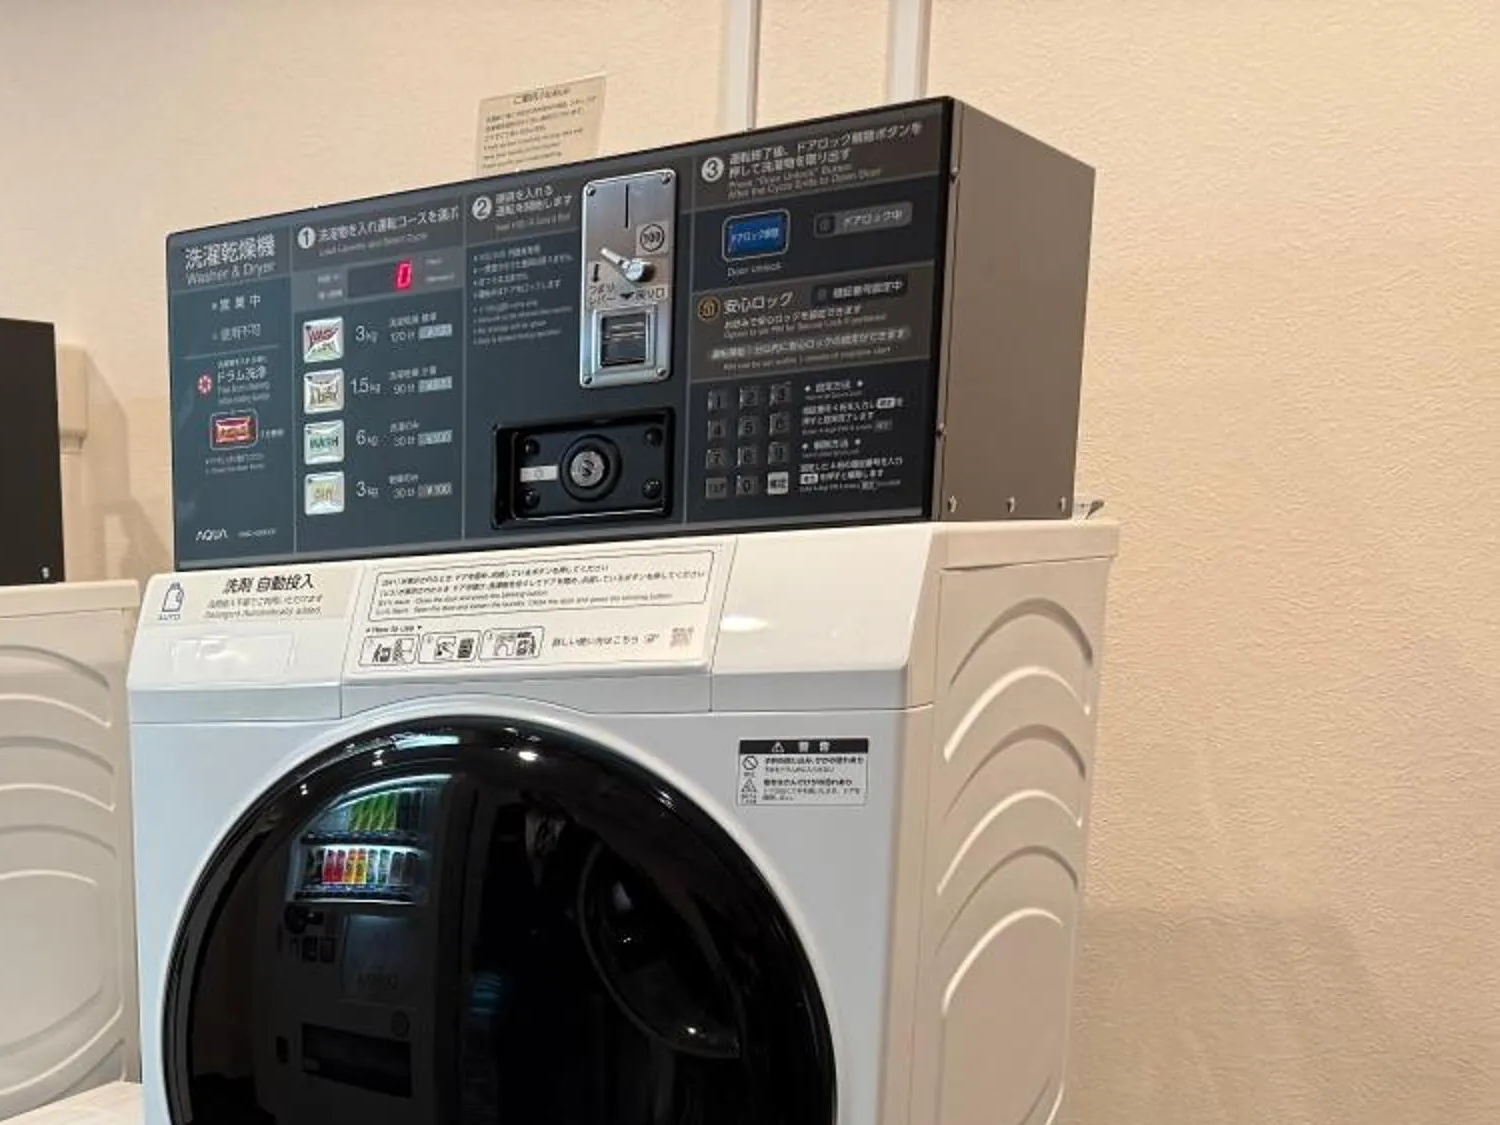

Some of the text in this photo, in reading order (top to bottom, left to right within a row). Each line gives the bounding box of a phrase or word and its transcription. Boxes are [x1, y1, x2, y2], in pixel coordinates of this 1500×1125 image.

[185, 233, 276, 271] 洗濯乾燥機
[723, 291, 793, 315] 安心ロック
[222, 573, 315, 595] 洗剤 自動投入
